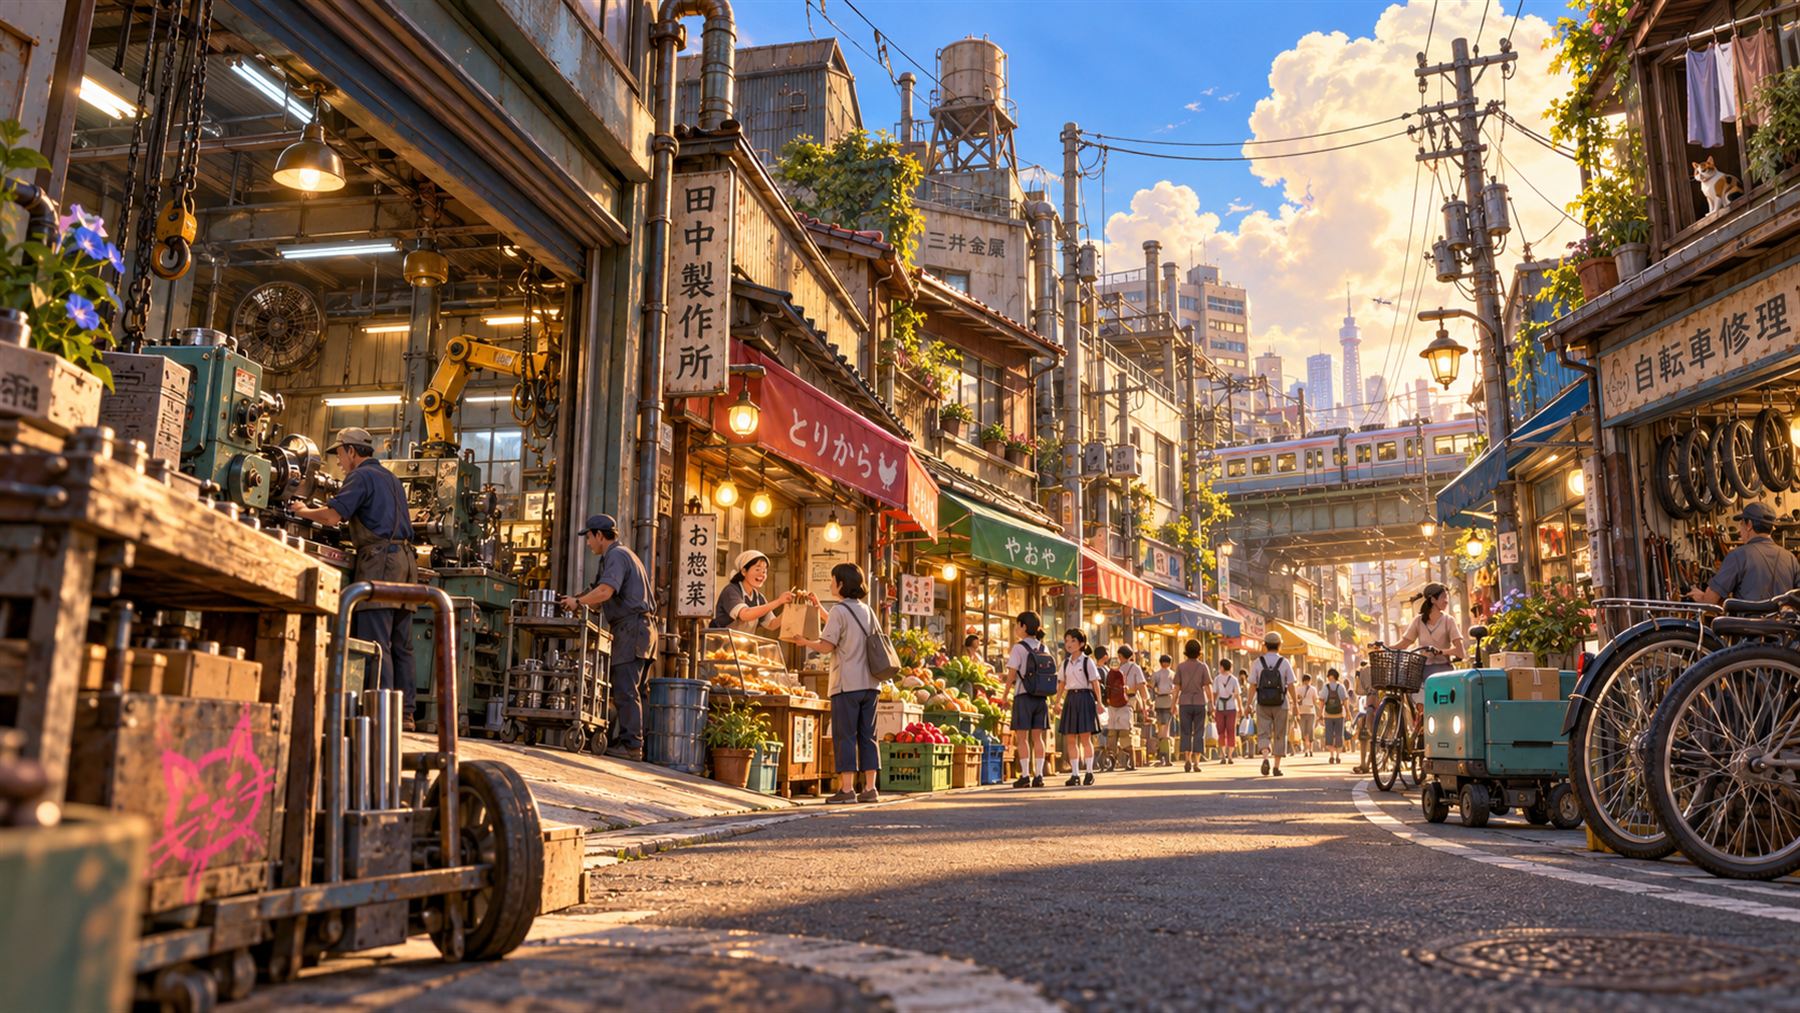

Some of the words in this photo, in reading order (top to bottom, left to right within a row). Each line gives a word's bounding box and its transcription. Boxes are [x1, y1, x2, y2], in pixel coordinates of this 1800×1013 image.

[676, 185, 715, 380] 田中製作所
[1634, 293, 1791, 394] 自転車修理
[789, 408, 872, 479] とりから
[686, 524, 708, 607] お惣菜
[1005, 536, 1056, 570] やおや
